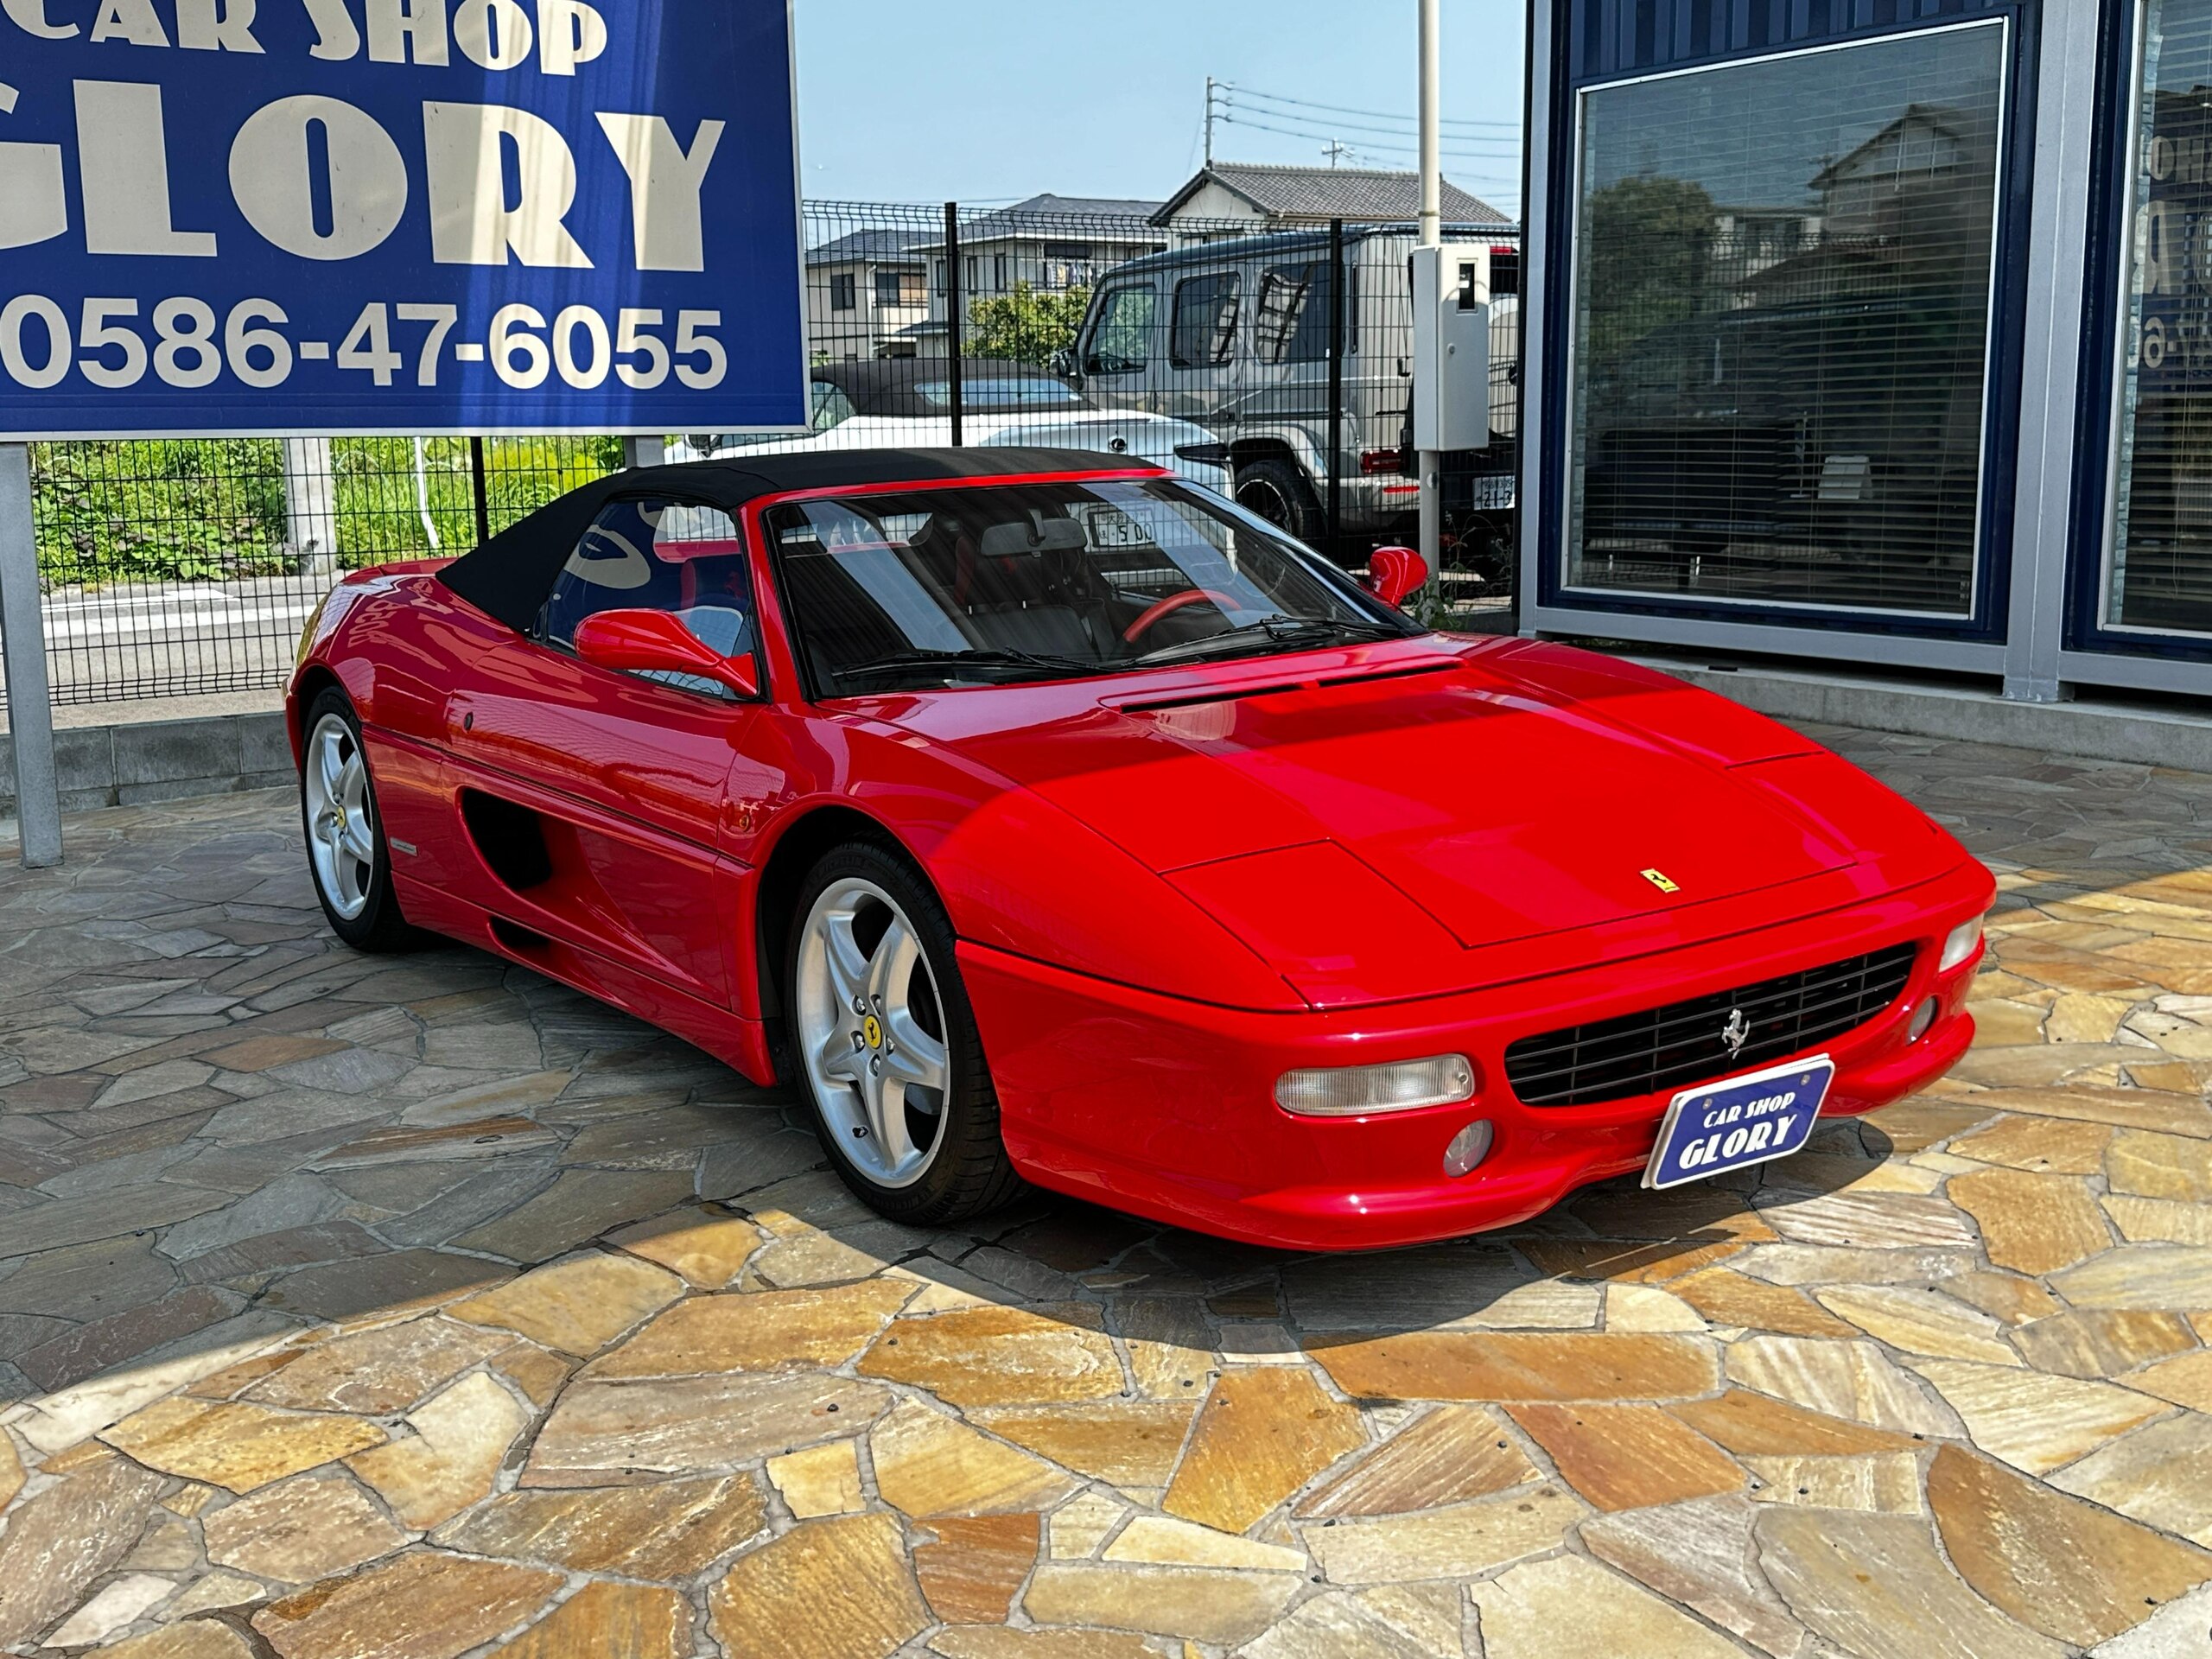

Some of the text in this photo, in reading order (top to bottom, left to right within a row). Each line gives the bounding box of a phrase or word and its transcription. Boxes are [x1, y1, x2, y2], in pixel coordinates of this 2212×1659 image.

[304, 0, 607, 76] SHOP
[0, 294, 728, 390] 0586-47-6055
[1679, 1114, 1797, 1170] GLORY
[1703, 1091, 1796, 1128] CAR SHOP
